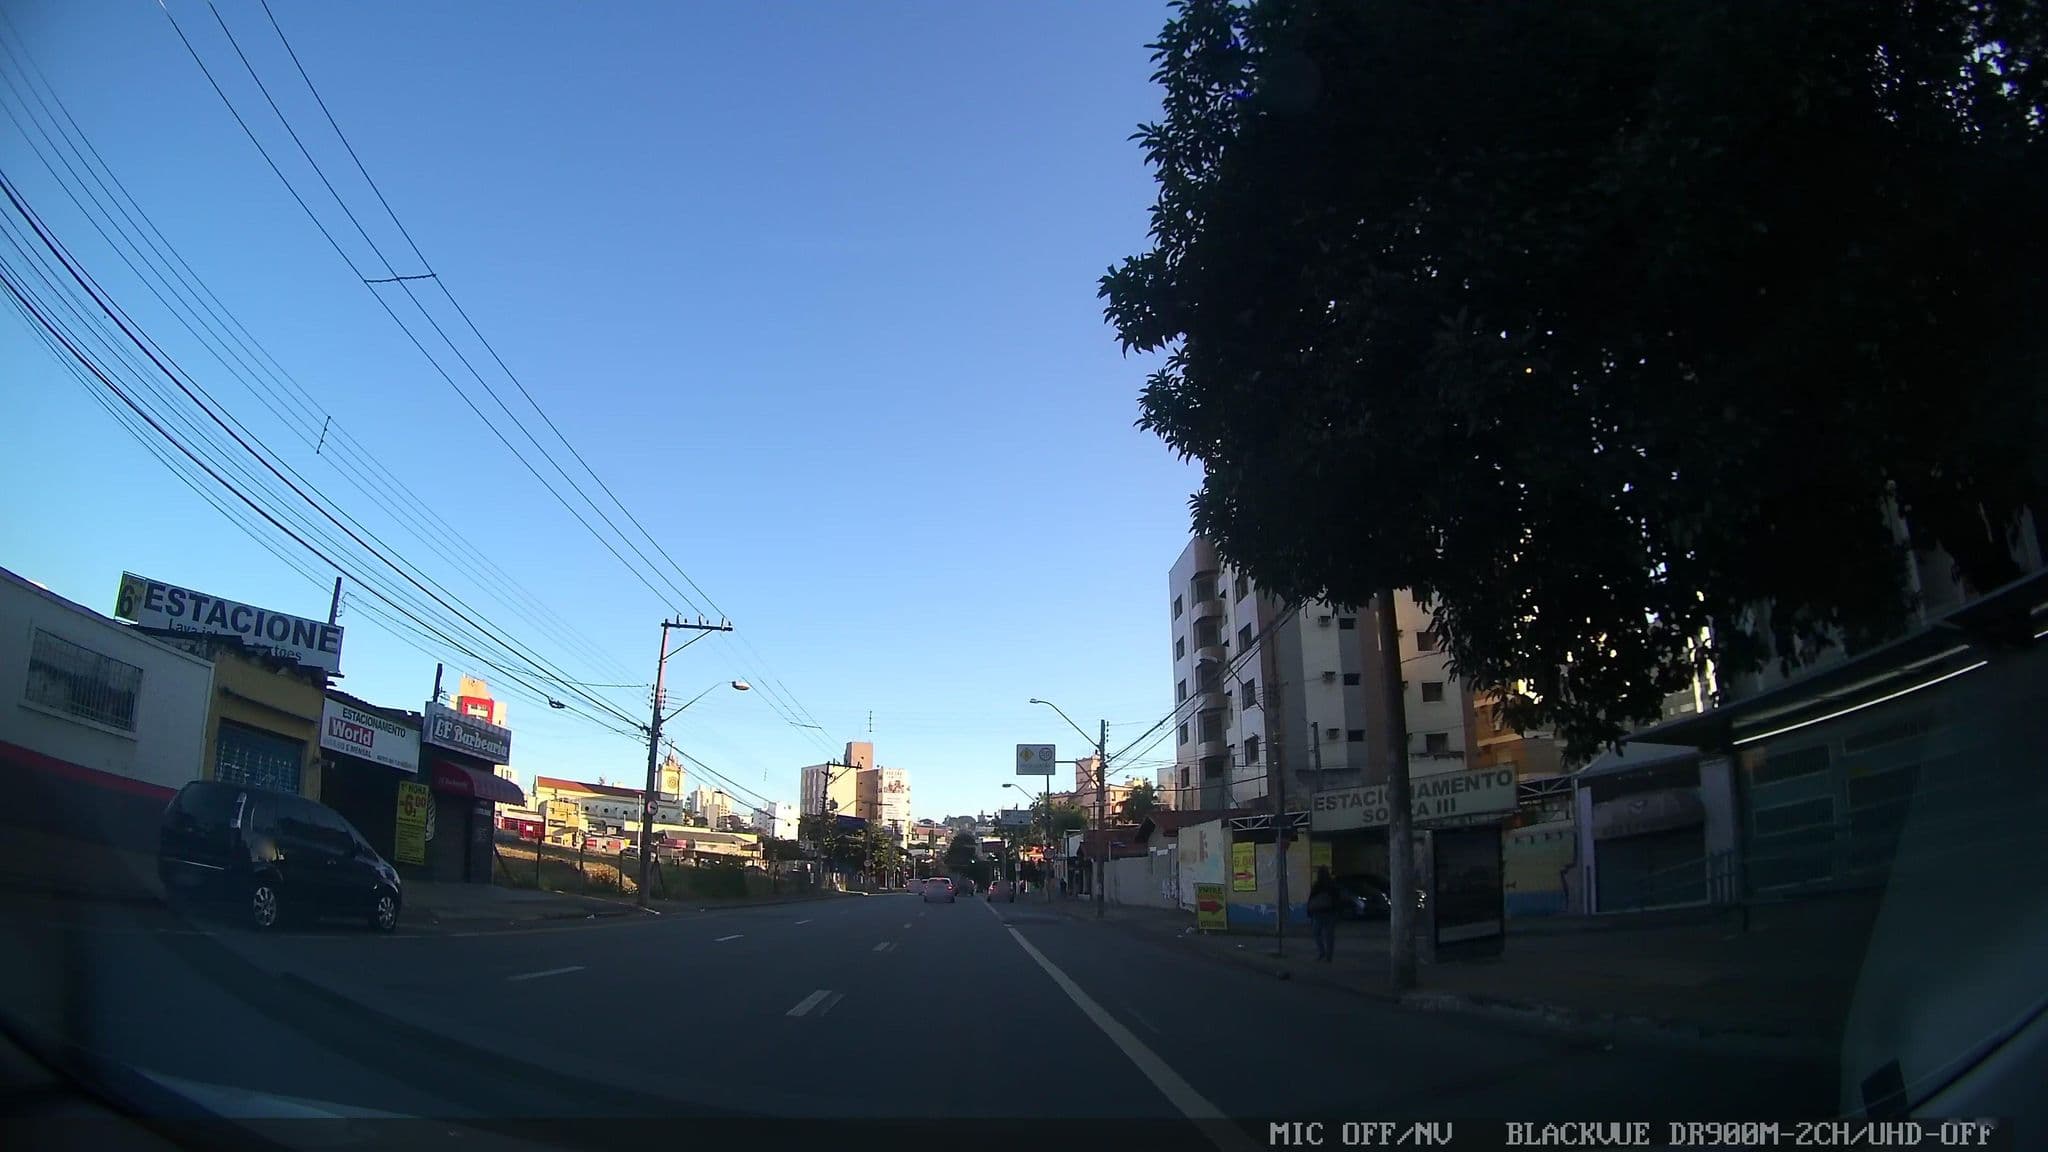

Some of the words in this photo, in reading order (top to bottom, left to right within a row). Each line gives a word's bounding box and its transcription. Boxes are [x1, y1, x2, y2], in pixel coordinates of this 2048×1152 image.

[144, 582, 340, 654] ESTACIONE
[332, 718, 372, 746] World
[342, 707, 406, 738] ESTACIONAMENTO
[454, 725, 508, 757] Barbearia
[1313, 769, 1512, 811] ESTACIAMENTO
[1437, 798, 1456, 813] III
